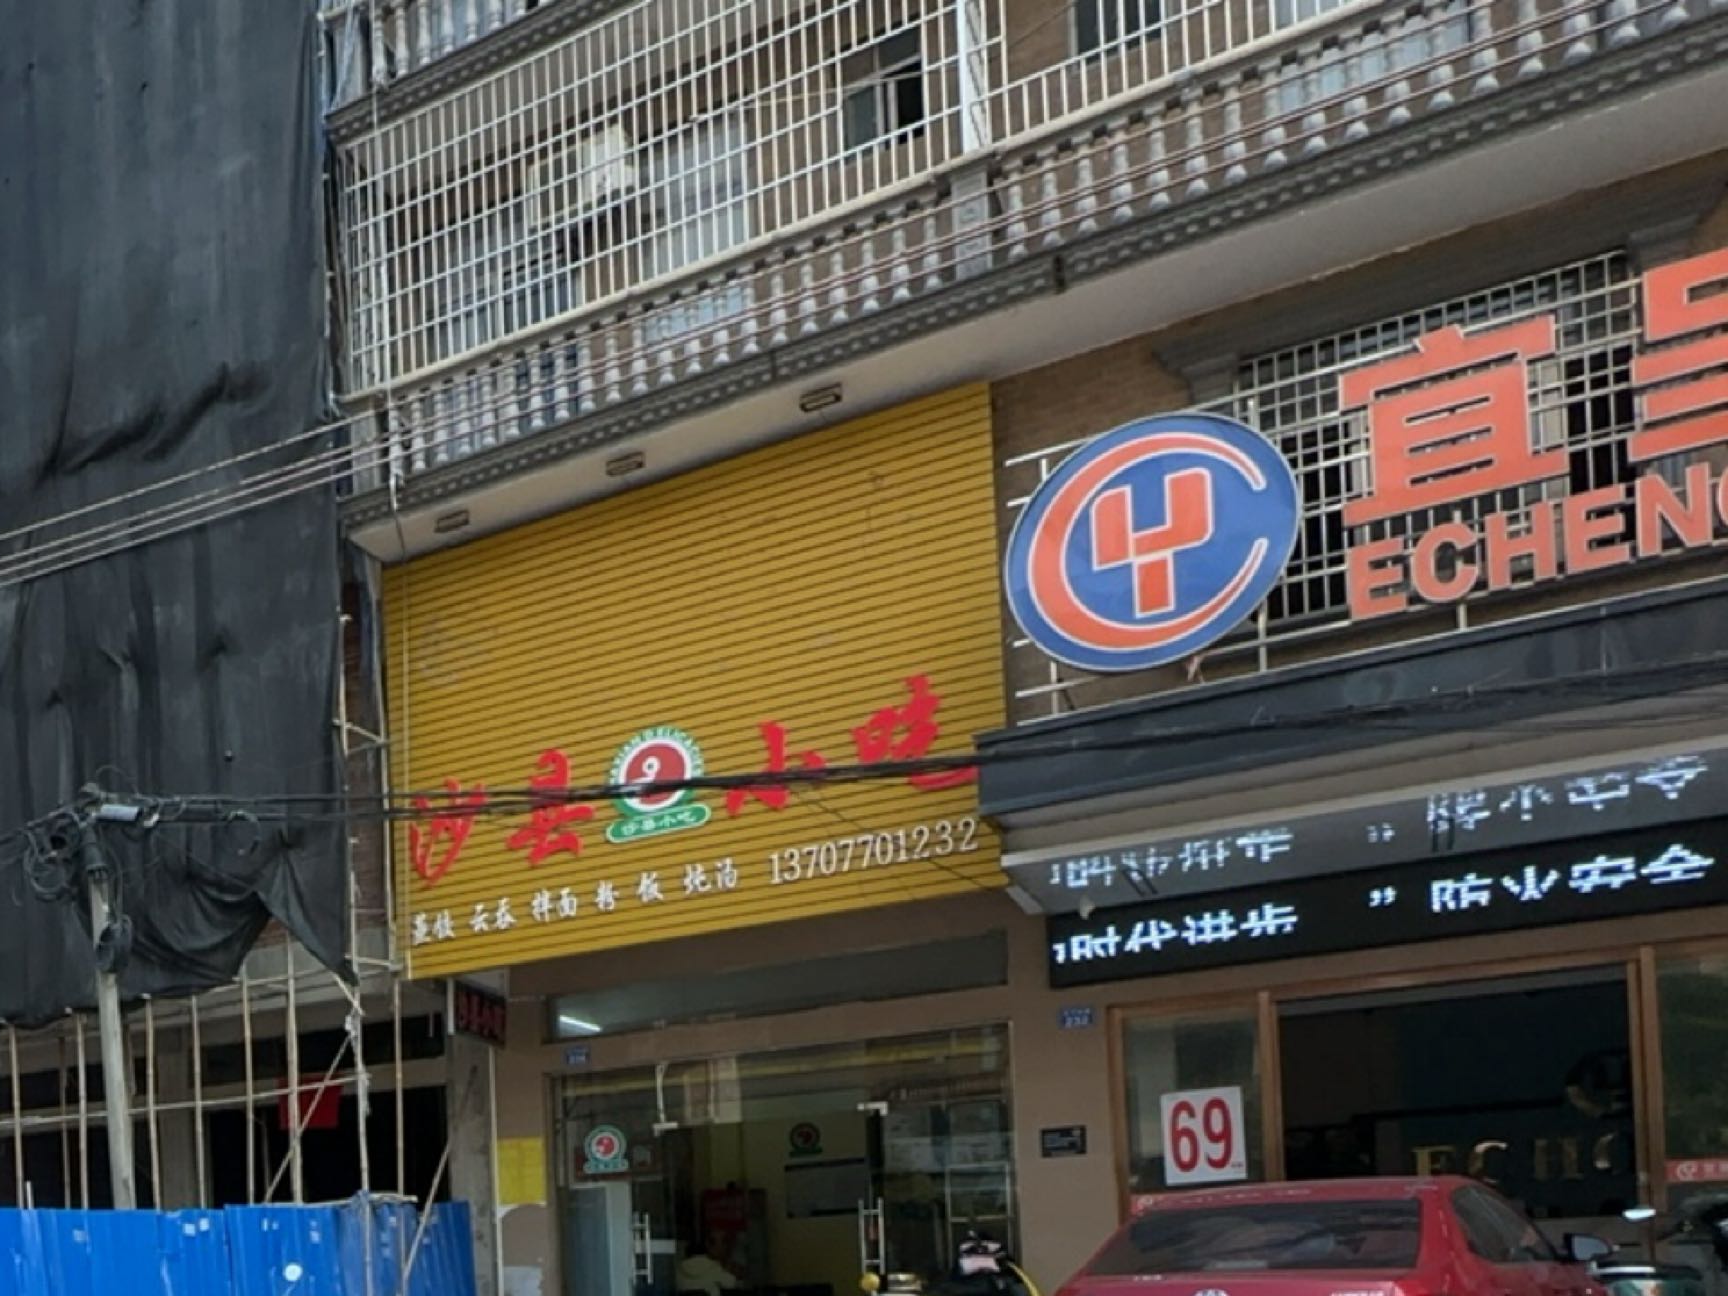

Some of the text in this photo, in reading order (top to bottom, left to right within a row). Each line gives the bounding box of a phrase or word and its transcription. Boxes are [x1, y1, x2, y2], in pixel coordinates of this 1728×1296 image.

[1346, 455, 1728, 621] ECHEN
[768, 818, 978, 884] 13707701232
[1052, 903, 1299, 963] 时代进步
[1430, 844, 1716, 913] 防火安全
[1169, 1096, 1233, 1173] 69
